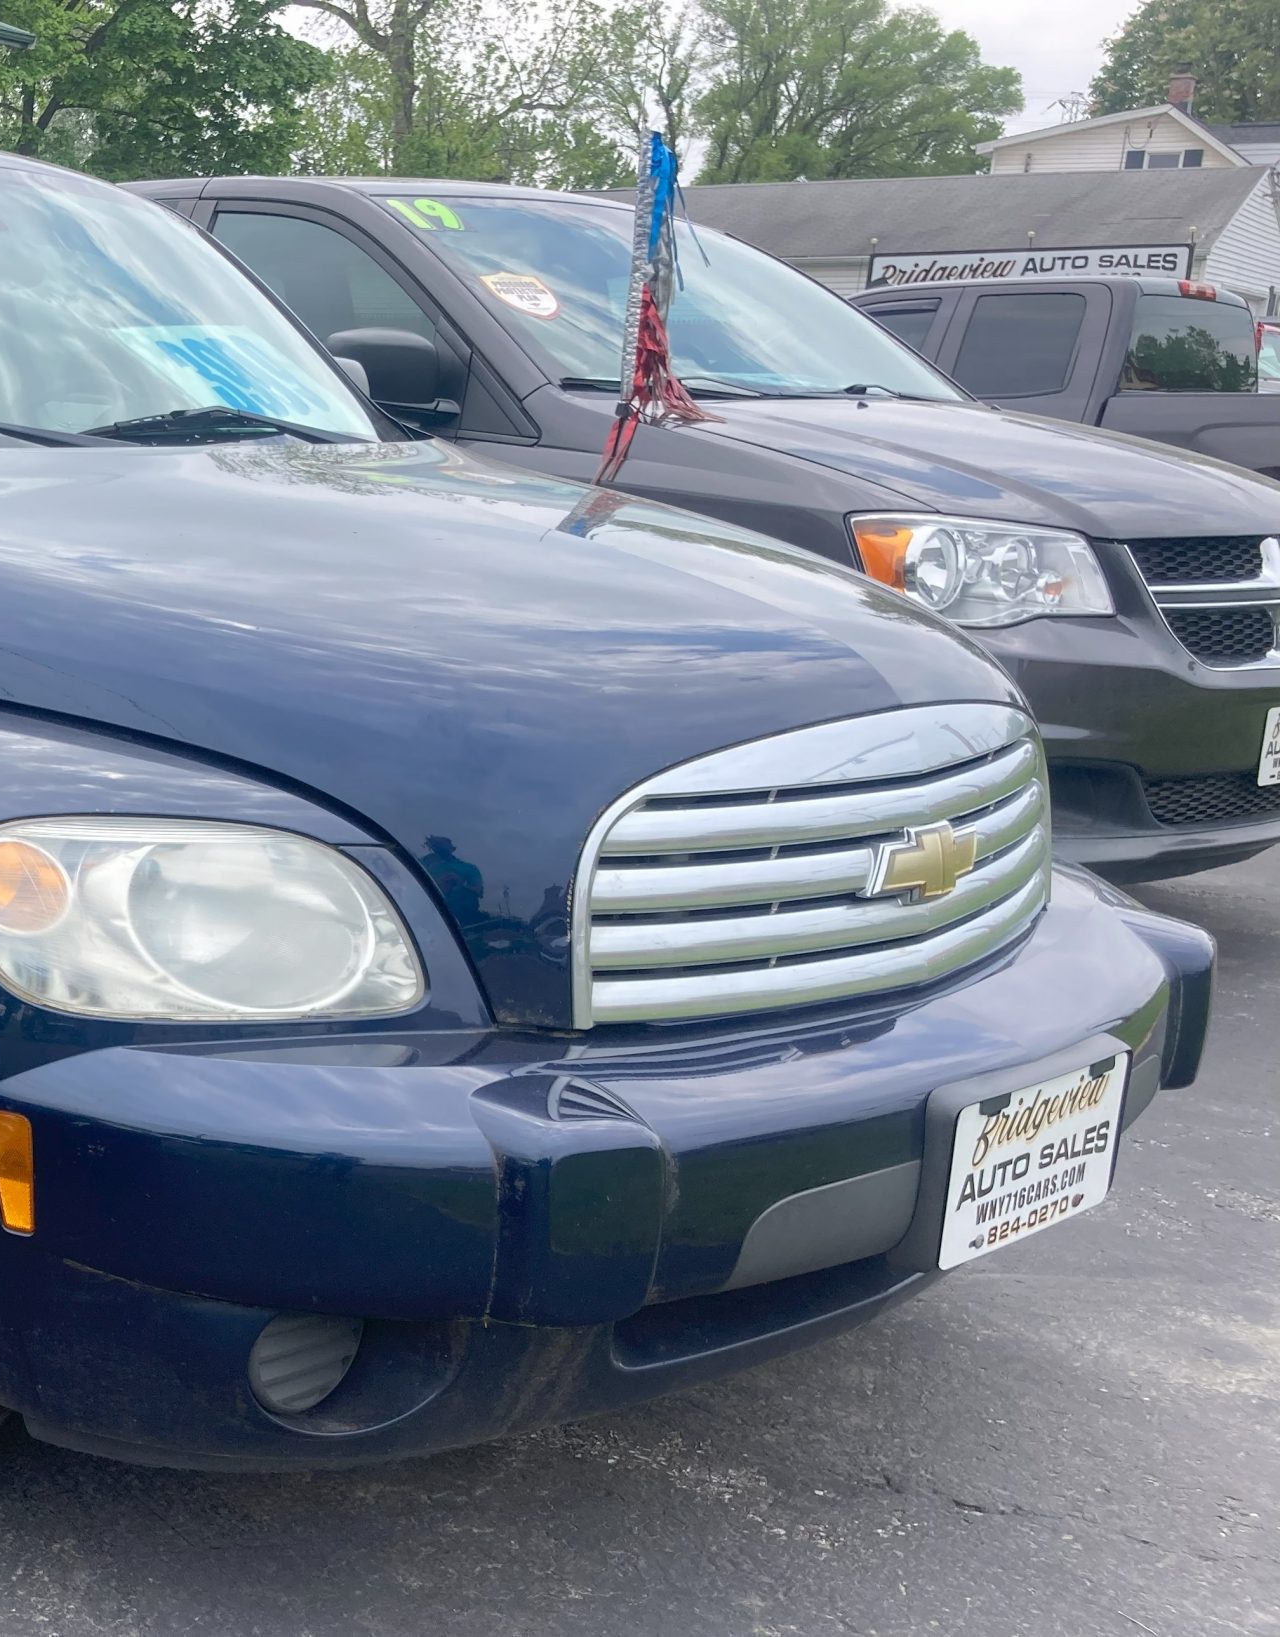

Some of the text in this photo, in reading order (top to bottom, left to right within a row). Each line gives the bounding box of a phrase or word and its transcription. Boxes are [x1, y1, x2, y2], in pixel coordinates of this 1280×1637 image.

[386, 198, 465, 231] 19
[1020, 255, 1089, 277] AUTO
[1098, 253, 1179, 272] SALES
[972, 1074, 1110, 1167] Bridgeview
[955, 1120, 1110, 1212] AUTO SALES
[976, 1162, 1086, 1226] WNY716CARS.COM
[987, 1195, 1069, 1245] 824-0270
